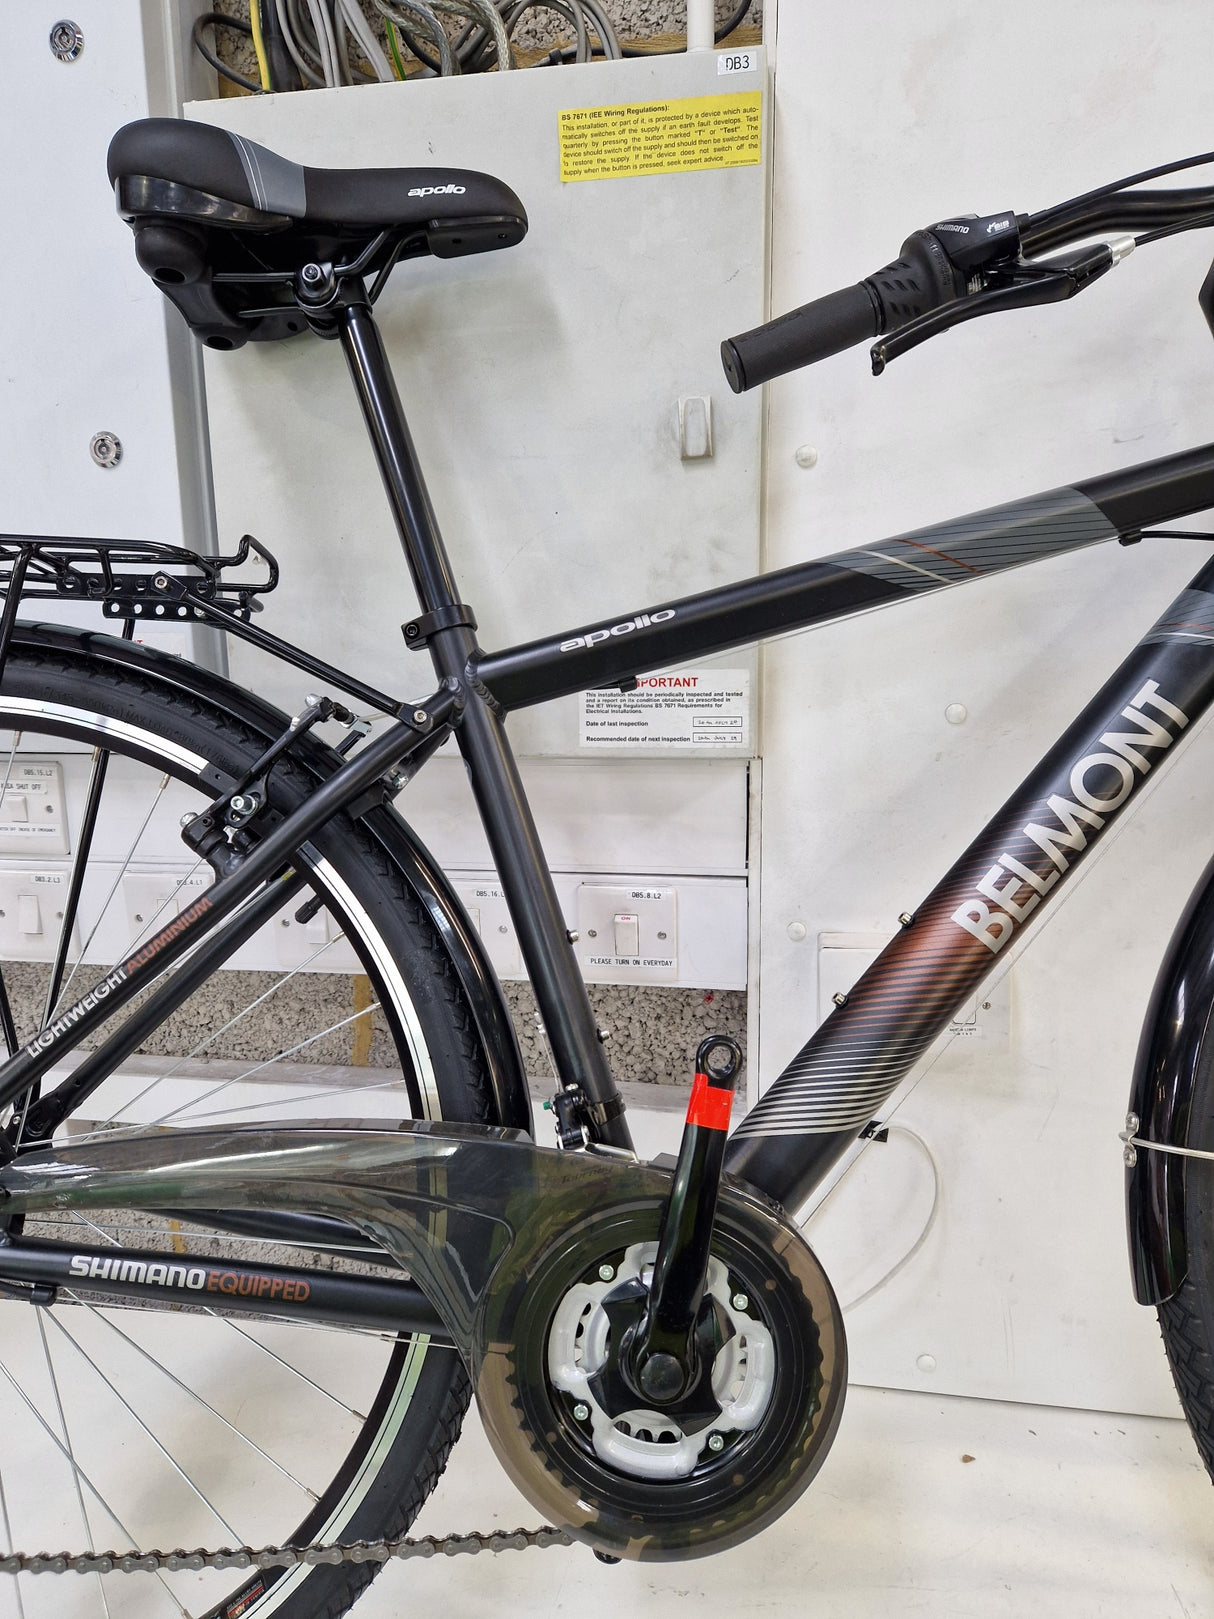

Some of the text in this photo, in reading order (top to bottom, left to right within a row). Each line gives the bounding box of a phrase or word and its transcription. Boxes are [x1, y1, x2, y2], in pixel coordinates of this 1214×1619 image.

[725, 55, 750, 70] DB3
[589, 111, 602, 119] (IEE
[627, 105, 670, 114] Regulations):
[656, 114, 683, 122] protected
[591, 130, 615, 138] switches
[603, 138, 628, 148] pressing
[668, 131, 690, 139] marked
[564, 168, 582, 176] supply
[407, 184, 466, 197] apollo
[935, 223, 969, 233] SHIMANO
[560, 609, 676, 652] apollo
[636, 677, 699, 688] PORTANT
[951, 679, 1190, 953] BELMONT
[615, 958, 630, 966] TURN
[26, 897, 213, 1058] LIGHTWEIGHT ALUMINIUM
[69, 1255, 310, 1301] SHIMANO EQUIPPED
